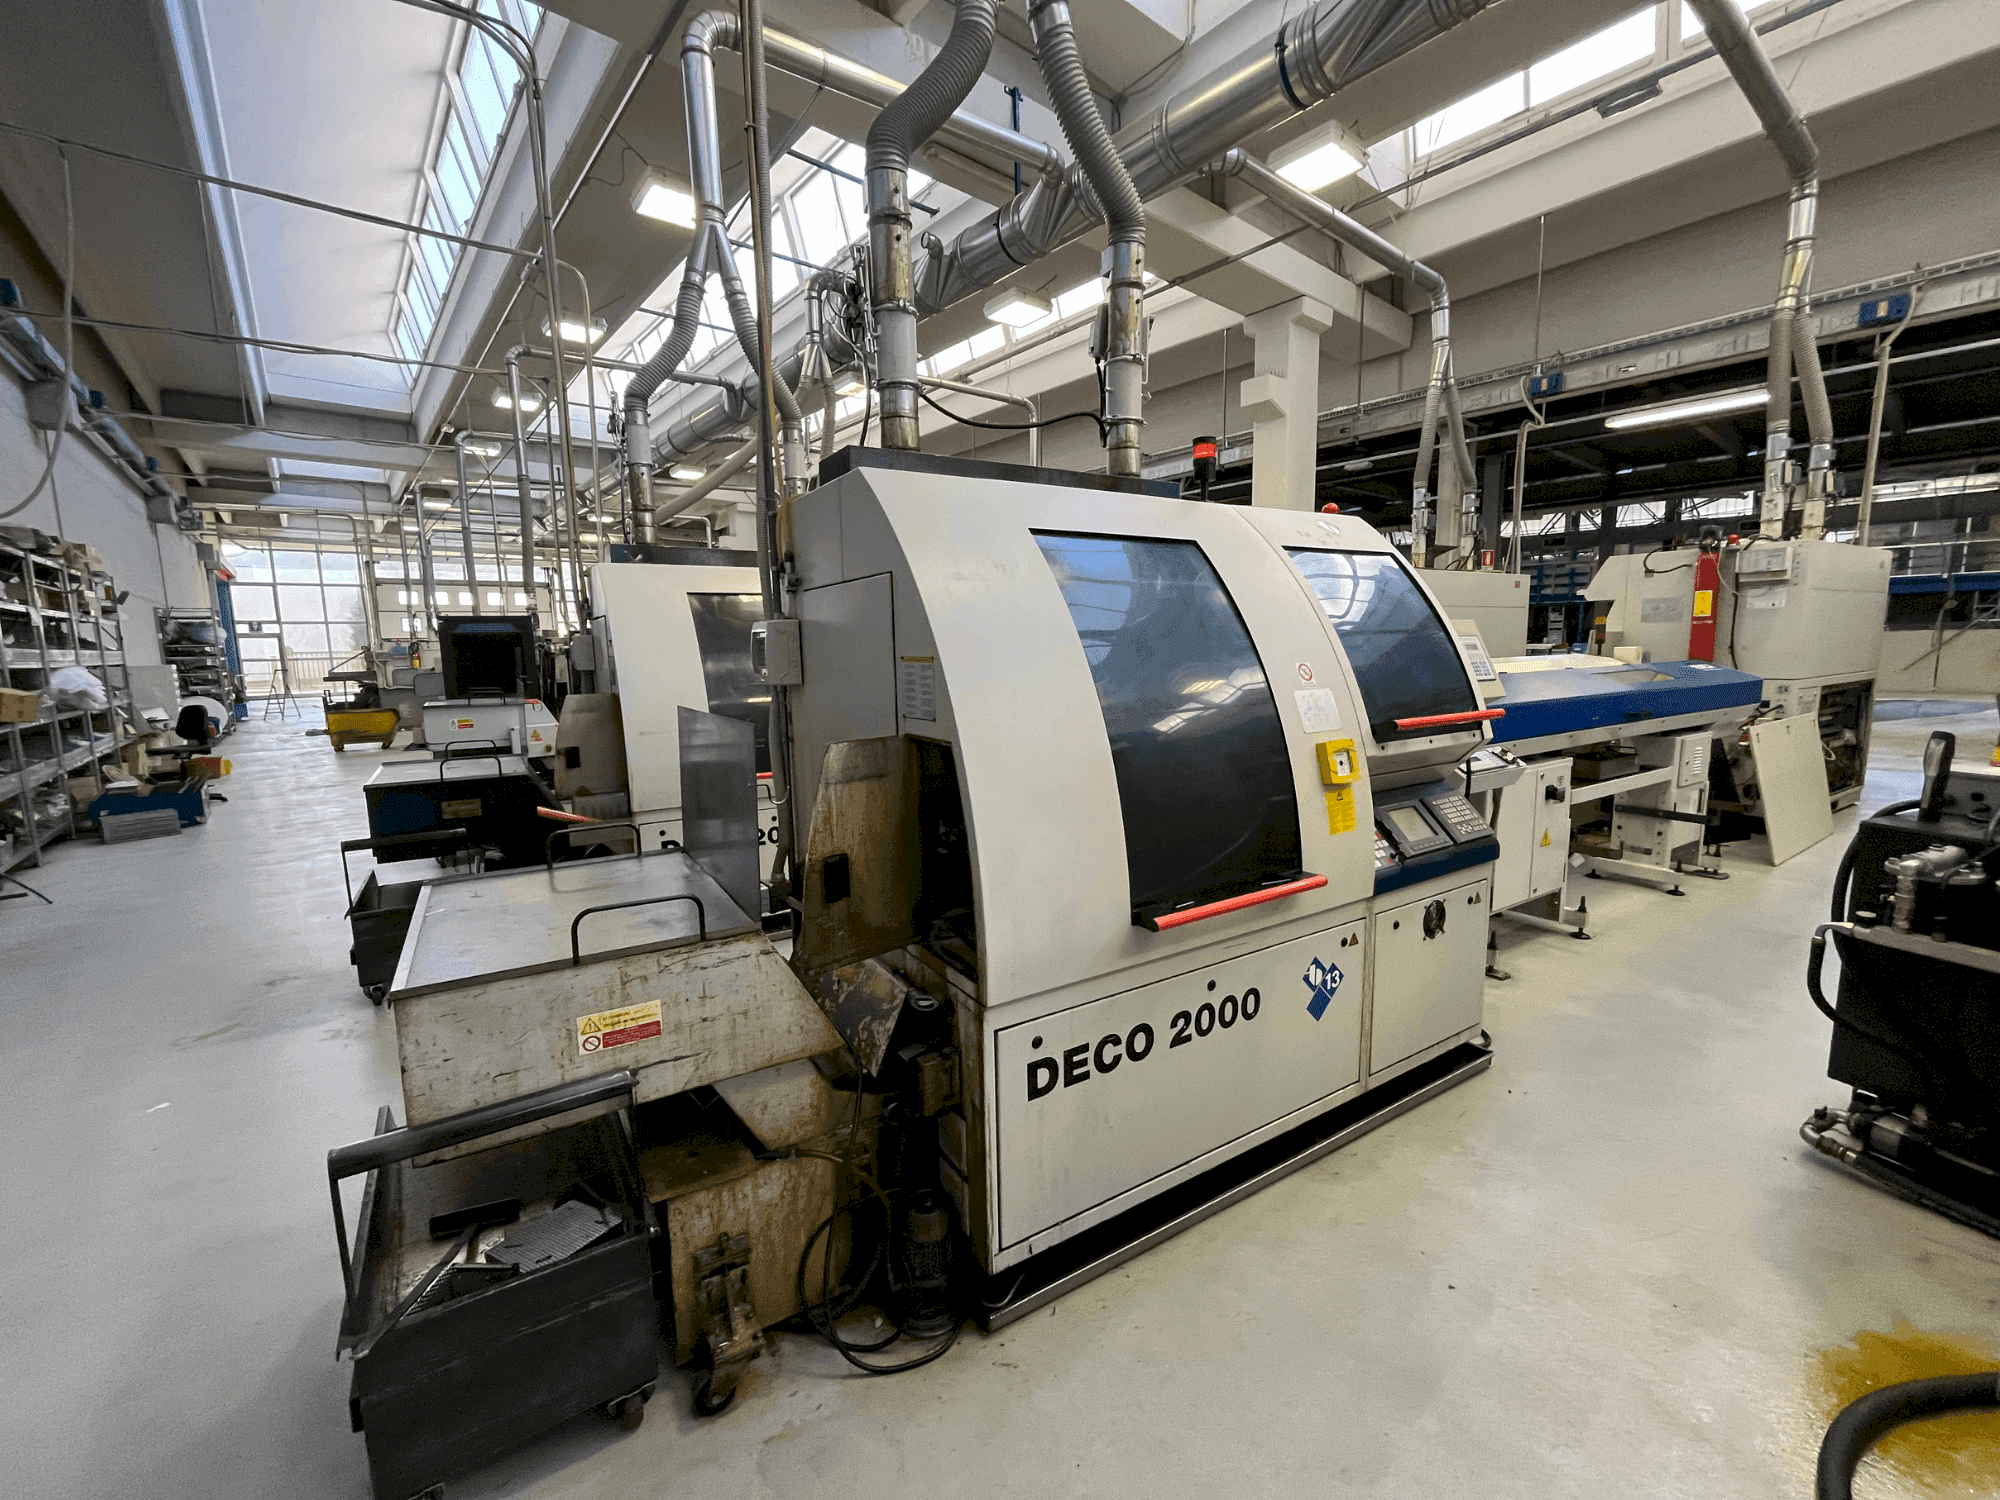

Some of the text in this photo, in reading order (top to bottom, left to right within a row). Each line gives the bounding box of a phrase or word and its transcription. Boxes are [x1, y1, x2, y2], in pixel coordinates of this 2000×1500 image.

[1325, 970, 1340, 990] 13
[1027, 987, 1261, 1102] DECO 2000
